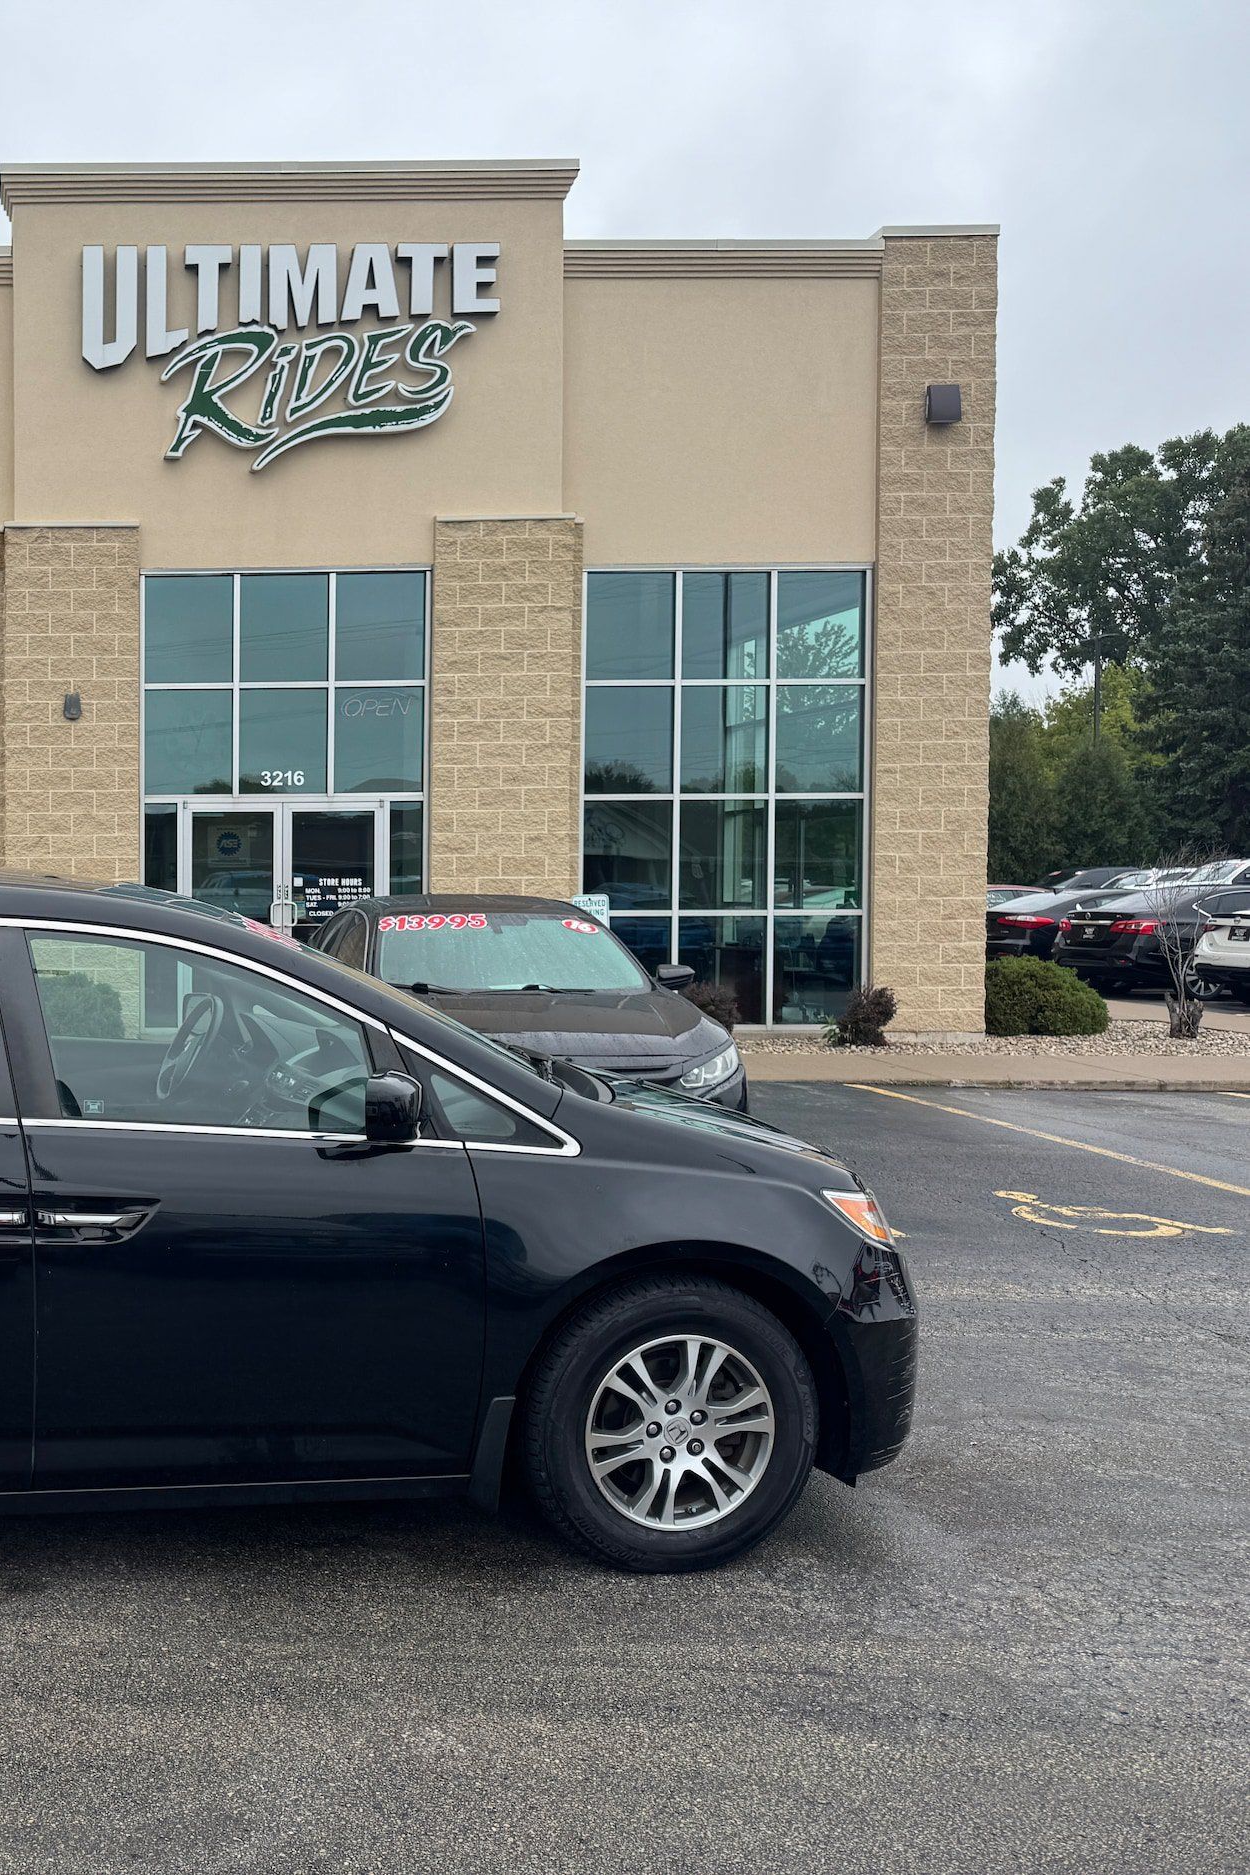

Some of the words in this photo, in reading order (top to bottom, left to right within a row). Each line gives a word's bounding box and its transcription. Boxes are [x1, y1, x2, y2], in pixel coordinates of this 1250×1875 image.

[82, 242, 500, 371] ULTIMATE
[344, 697, 412, 717] OPEN
[260, 770, 305, 787] 3216
[318, 878, 339, 886] STORE
[341, 878, 362, 886] HOURS
[378, 914, 488, 931] $13995
